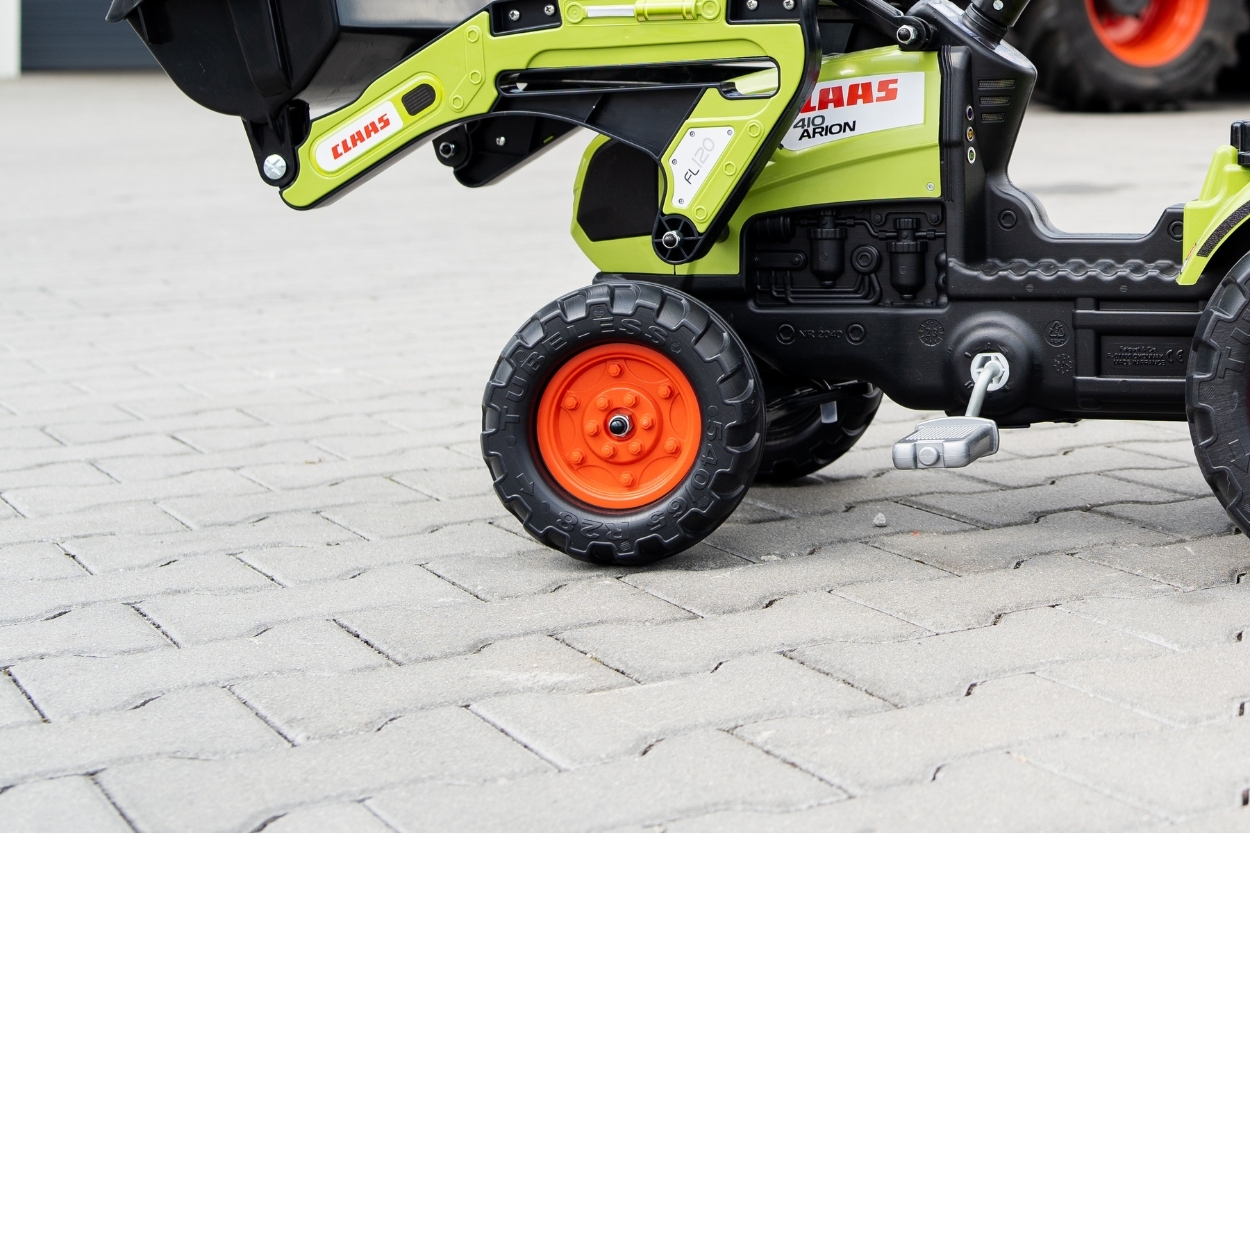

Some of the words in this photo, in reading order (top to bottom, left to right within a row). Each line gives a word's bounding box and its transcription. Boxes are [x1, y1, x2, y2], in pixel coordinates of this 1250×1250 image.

[331, 112, 391, 161] CLAAS
[792, 114, 826, 129] 410
[798, 120, 857, 141] ARION
[500, 316, 669, 431] TUBELESS
